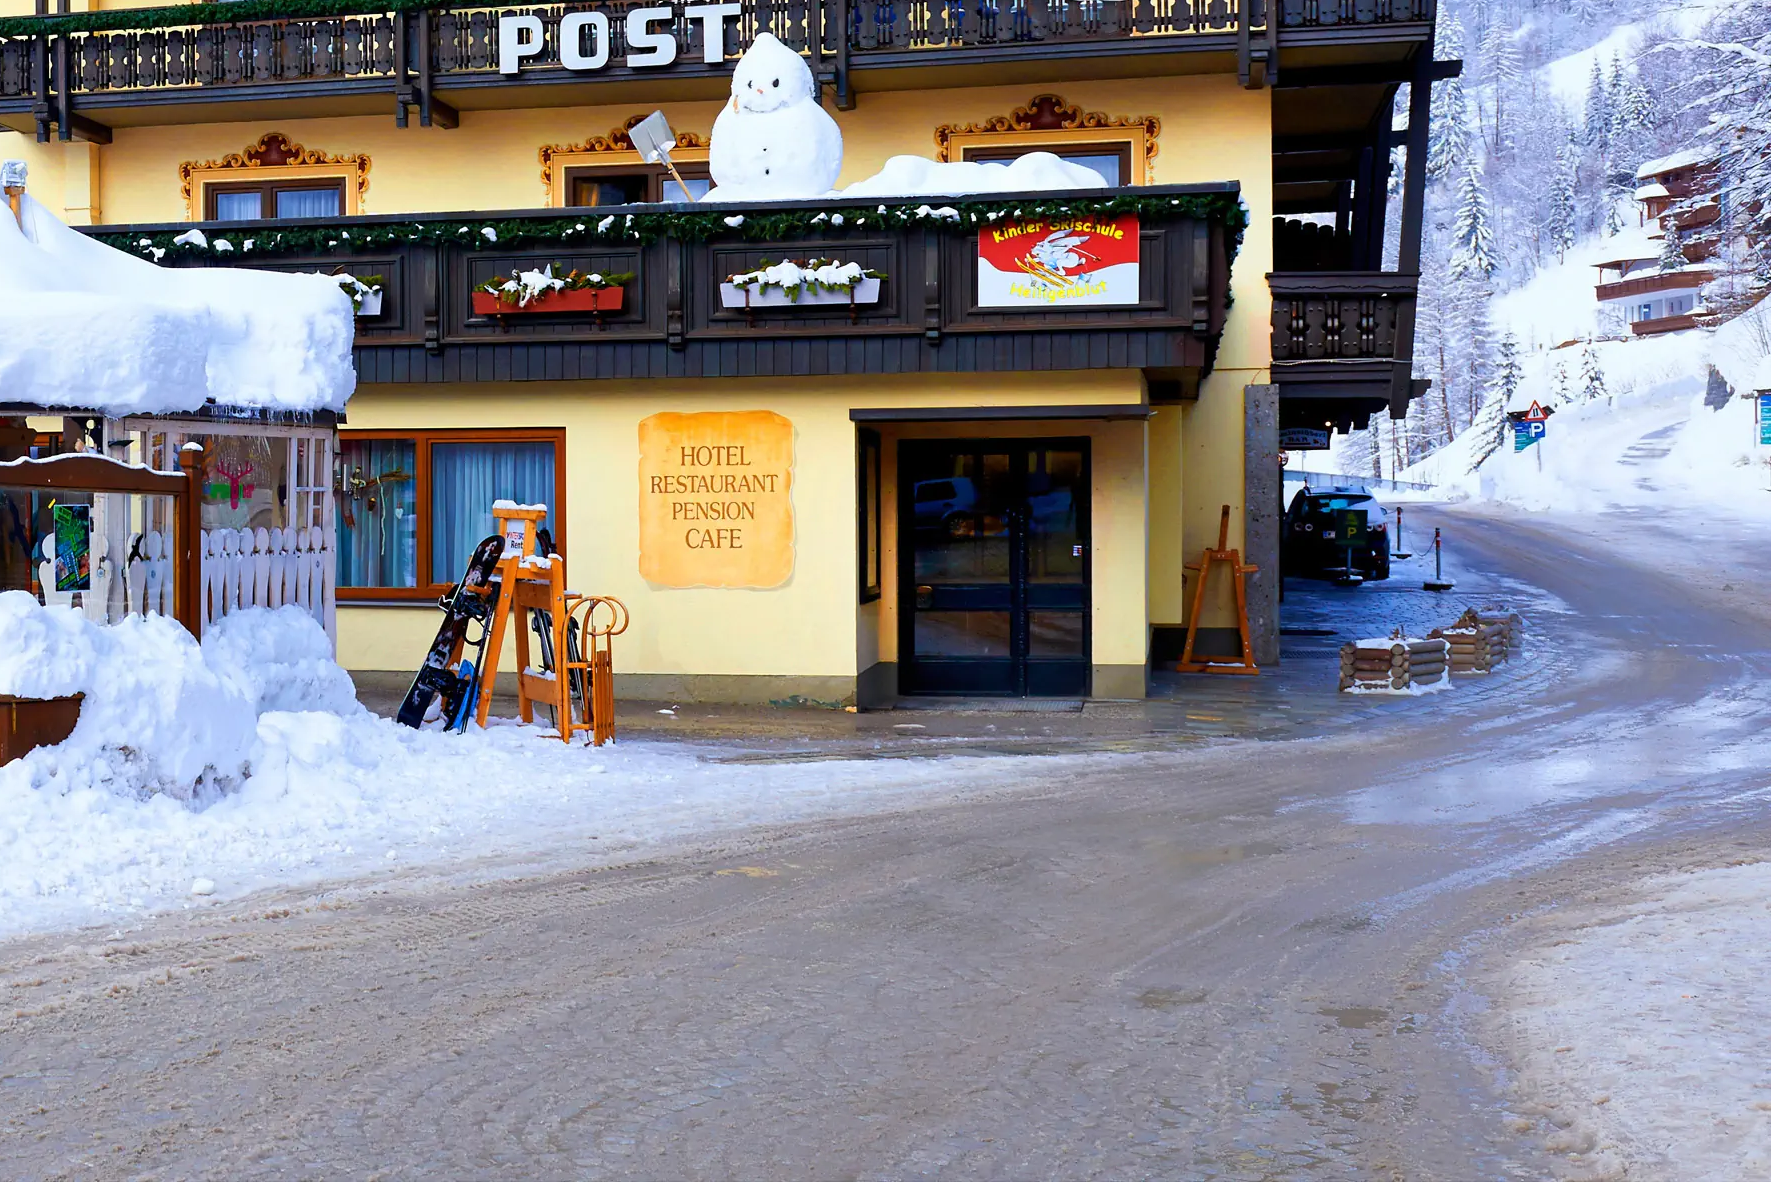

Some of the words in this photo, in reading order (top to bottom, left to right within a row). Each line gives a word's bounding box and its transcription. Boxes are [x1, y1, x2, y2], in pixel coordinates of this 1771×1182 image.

[499, 2, 741, 75] POST
[992, 222, 1043, 243] Kinder
[1049, 219, 1124, 240] Skischule
[1010, 280, 1108, 302] Heiligenblut
[1530, 422, 1544, 438] P
[680, 445, 752, 467] HOTEL
[650, 474, 779, 494] RESTAURANT
[671, 501, 755, 521] PENSION
[685, 528, 743, 549] CAFE
